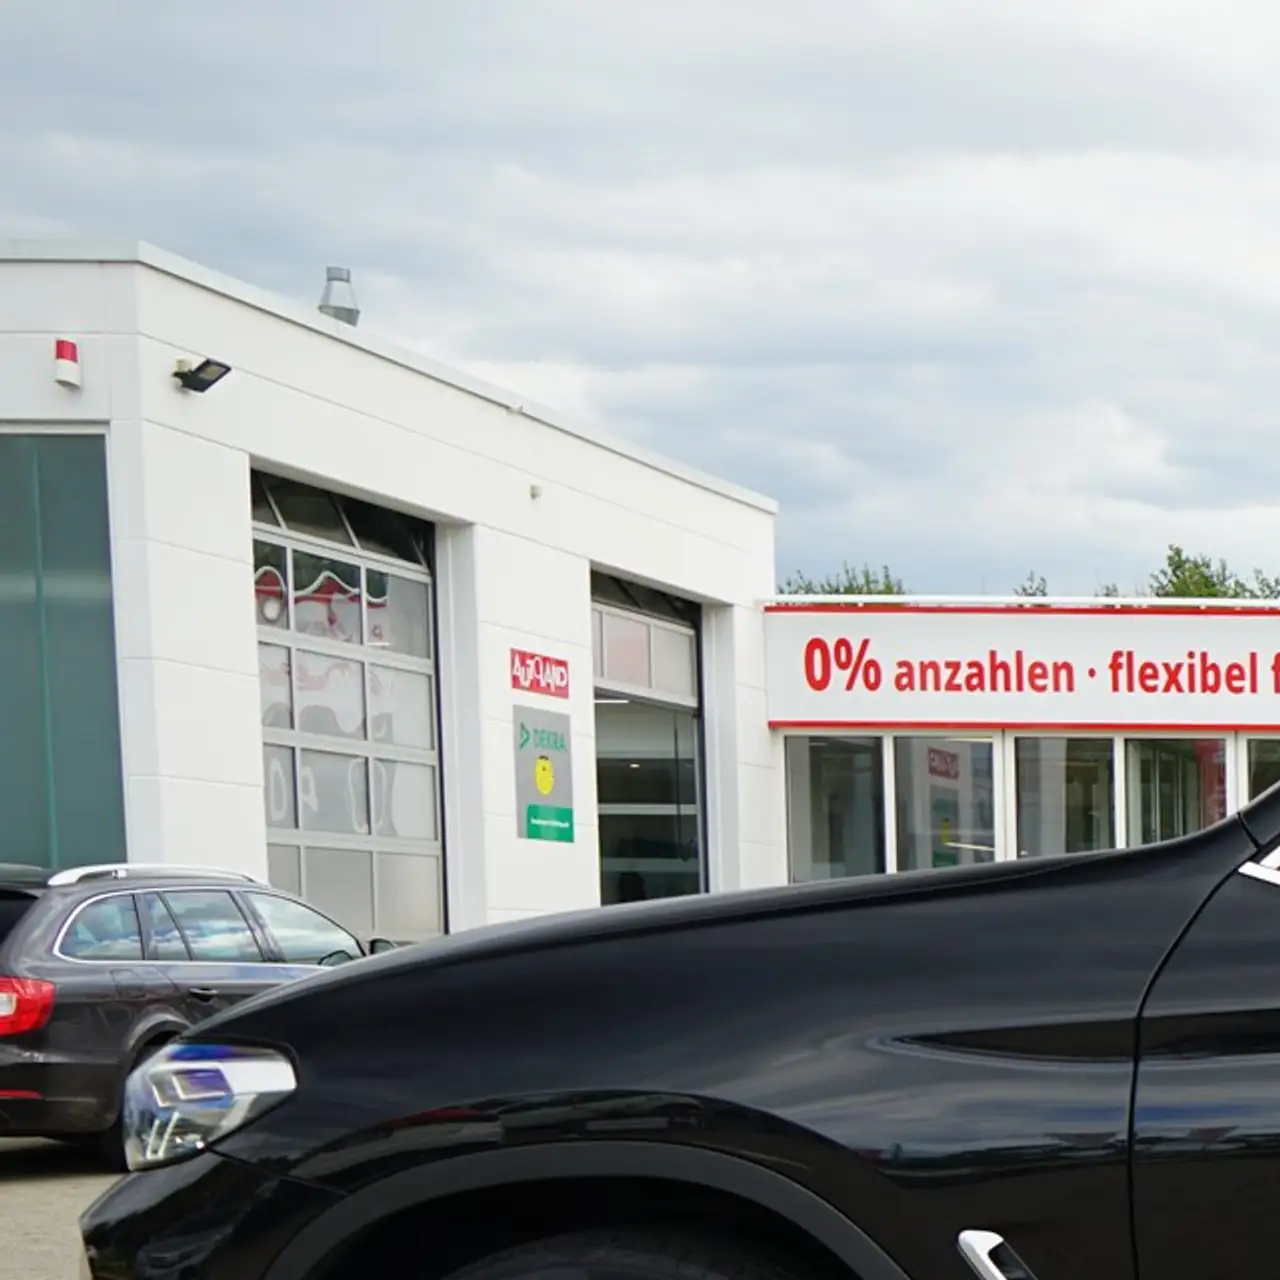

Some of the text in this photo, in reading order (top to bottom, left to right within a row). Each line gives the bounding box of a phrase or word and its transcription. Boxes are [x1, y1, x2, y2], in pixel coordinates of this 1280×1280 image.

[804, 637, 882, 692] 0%
[894, 650, 1076, 693] anzahlen
[1108, 650, 1258, 693] flexibel
